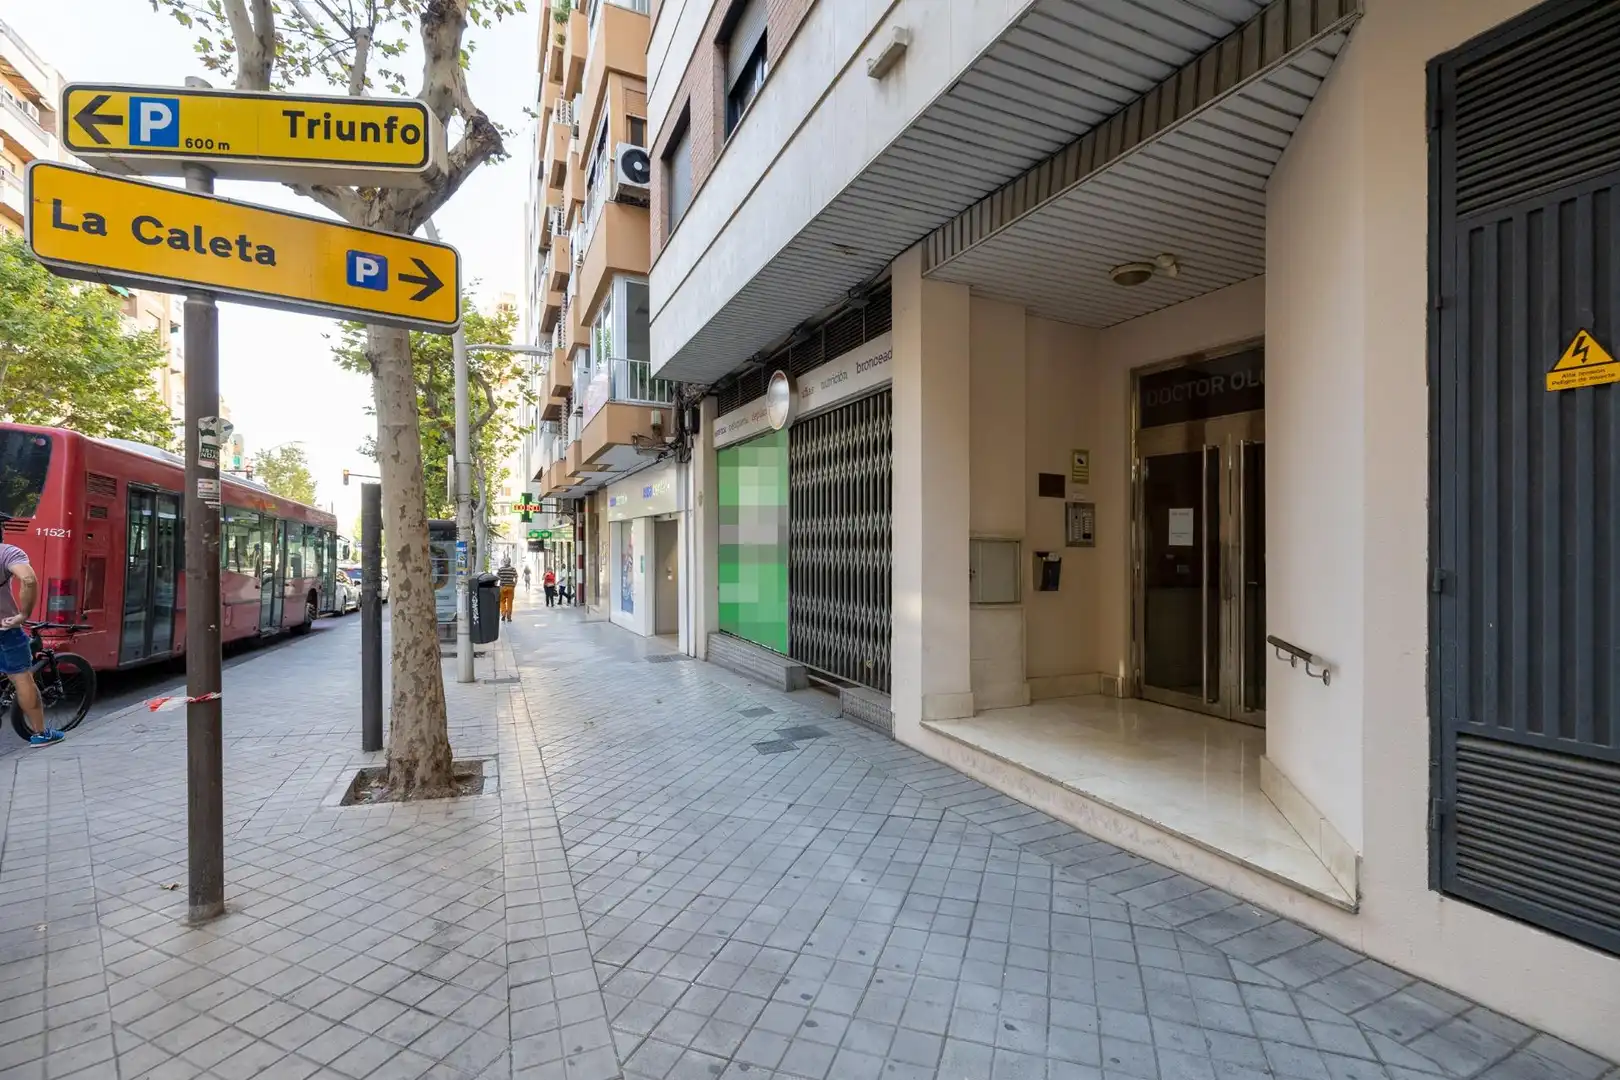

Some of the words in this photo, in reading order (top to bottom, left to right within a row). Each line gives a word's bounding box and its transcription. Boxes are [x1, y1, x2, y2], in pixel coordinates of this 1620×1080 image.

[140, 102, 172, 142] P
[282, 109, 421, 145] Triunfo
[185, 138, 214, 150] 600
[218, 141, 230, 150] m
[52, 198, 108, 236] La
[131, 215, 277, 267] Caleta
[355, 256, 380, 284] P
[1146, 376, 1225, 407] DOCTOR
[1230, 368, 1265, 390] OL
[36, 527, 72, 538] 11521
